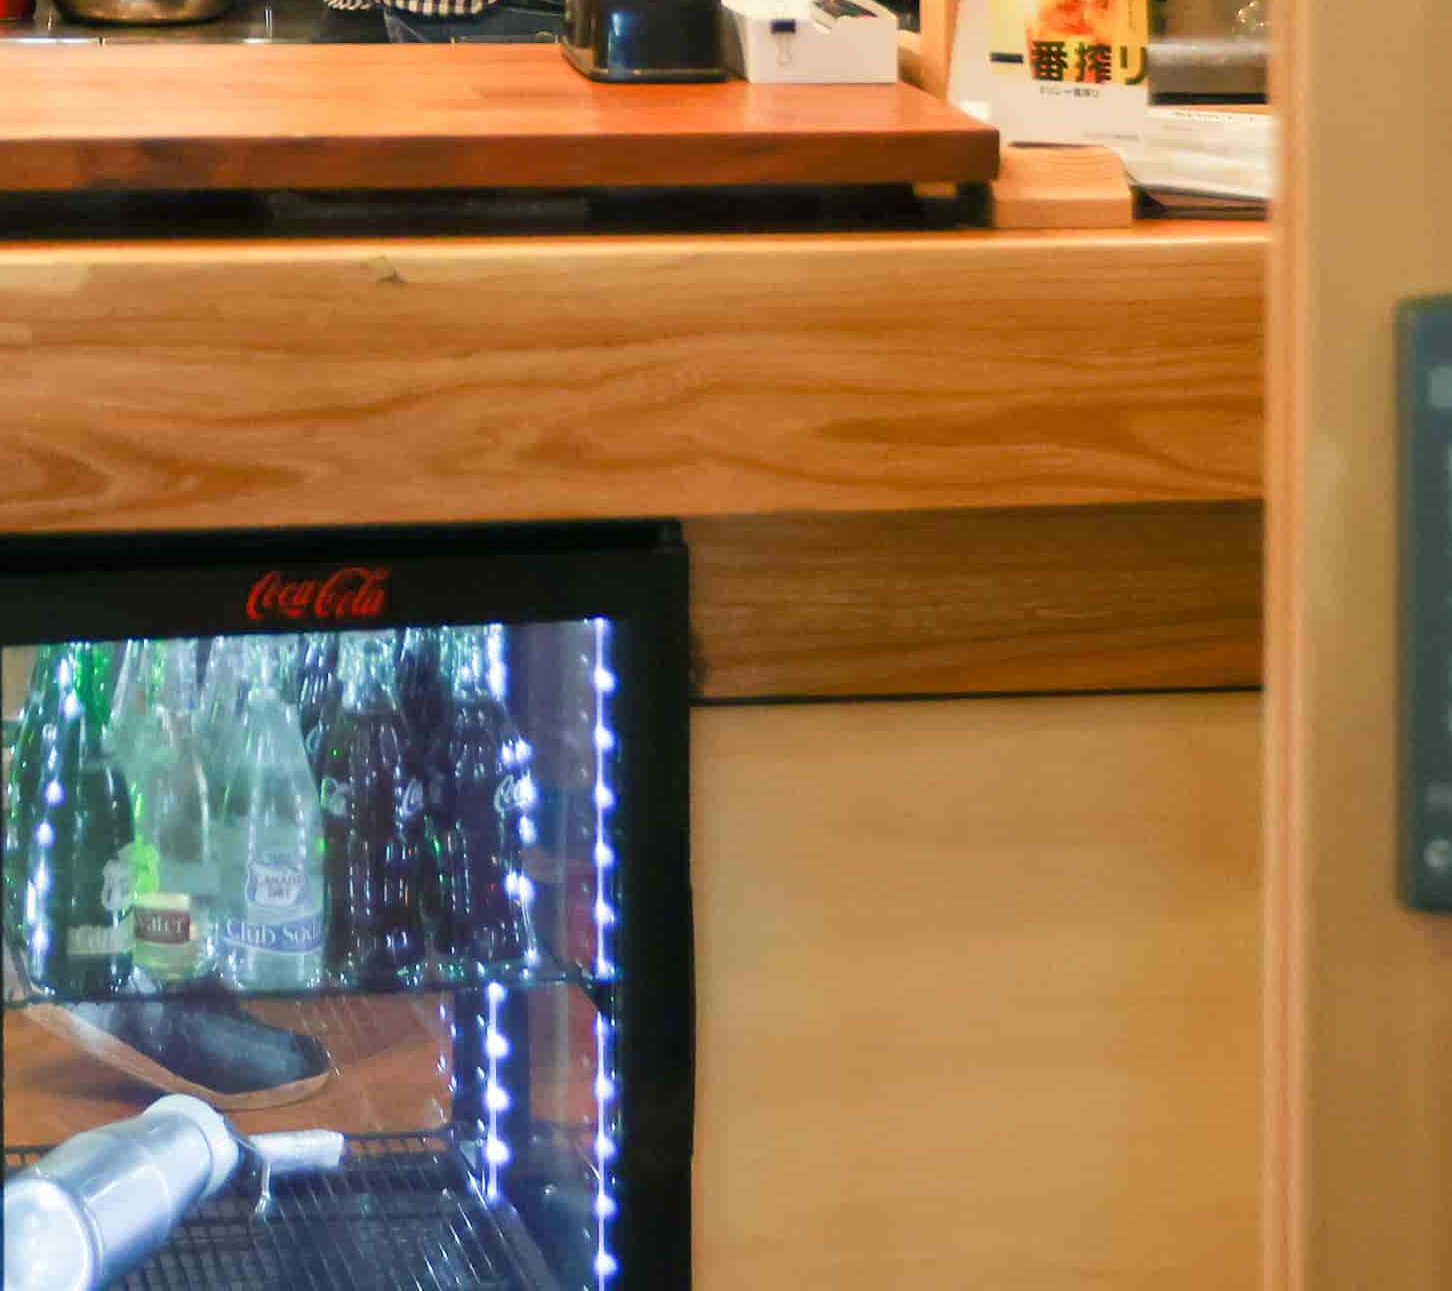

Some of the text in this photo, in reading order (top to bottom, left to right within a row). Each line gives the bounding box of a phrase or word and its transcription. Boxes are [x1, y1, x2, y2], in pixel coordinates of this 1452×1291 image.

[990, 40, 1147, 86] 一番搾り
[227, 920, 274, 942] Club
